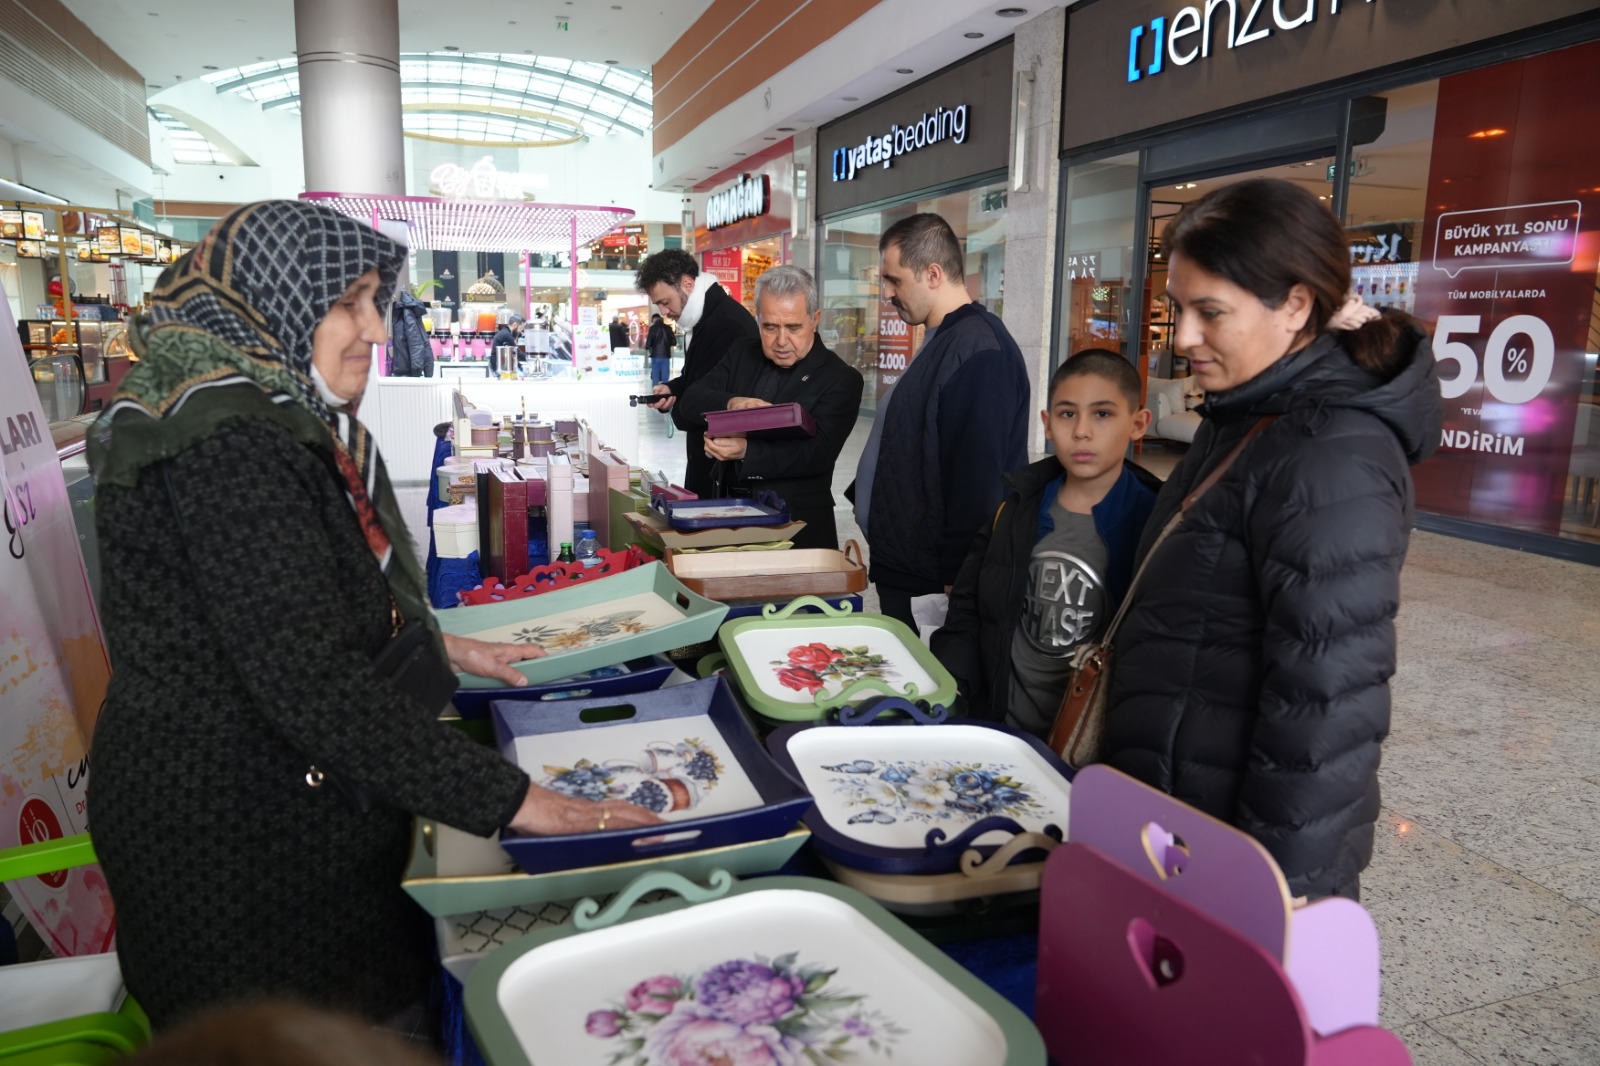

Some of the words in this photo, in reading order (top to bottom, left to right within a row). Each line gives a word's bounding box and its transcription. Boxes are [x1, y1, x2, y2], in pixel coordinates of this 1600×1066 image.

[847, 134, 893, 180] yataş
[893, 104, 967, 156] bedding
[706, 173, 764, 230] ARMAĞAN
[1444, 223, 1491, 240] BÜYÜK
[1494, 223, 1519, 237] YIL
[1523, 218, 1569, 234] SONU
[1447, 289, 1468, 300] TÜM
[1431, 314, 1555, 404] 50
[1507, 347, 1528, 373] %
[1439, 429, 1525, 456] NDİRİM
